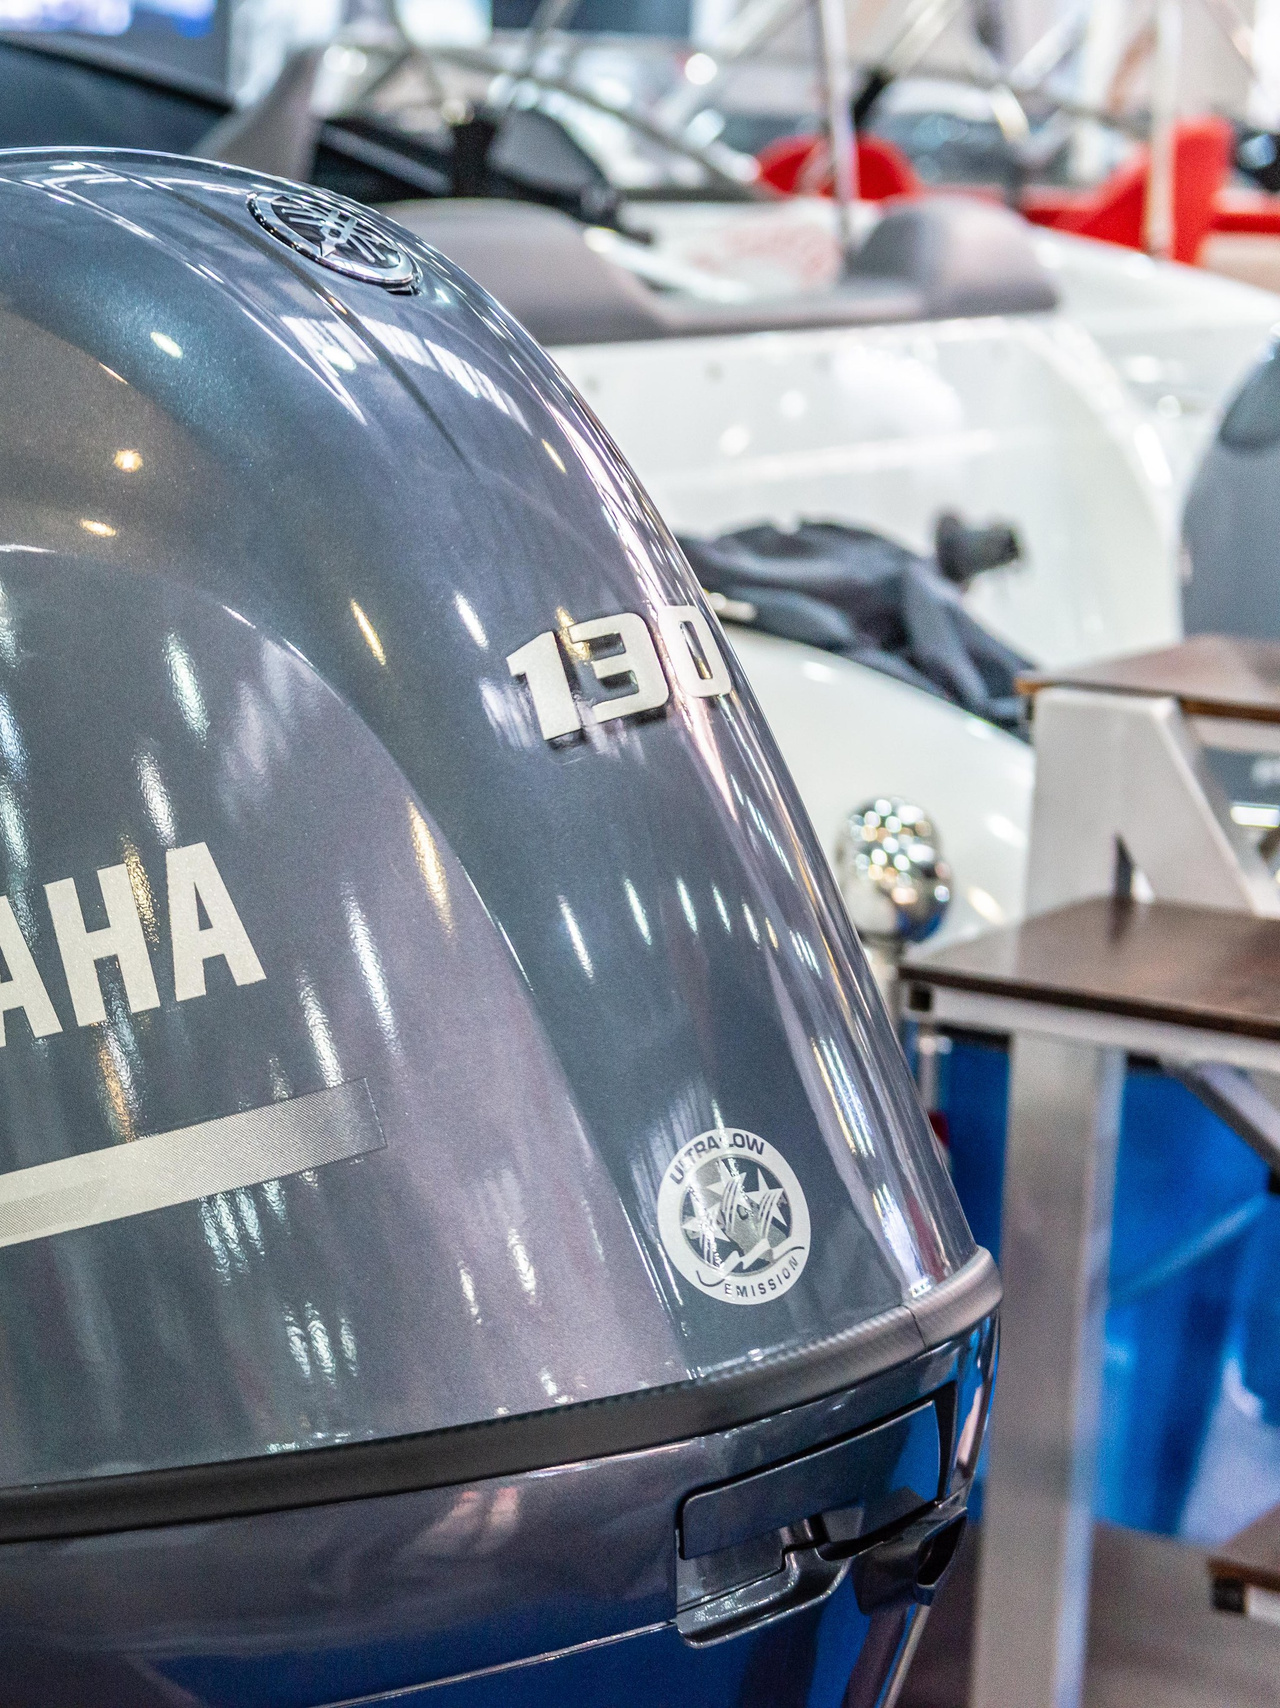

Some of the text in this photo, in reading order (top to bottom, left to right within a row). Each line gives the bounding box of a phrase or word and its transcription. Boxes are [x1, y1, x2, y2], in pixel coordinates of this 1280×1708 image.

[506, 605, 732, 741] 130
[669, 1132, 765, 1185] UTRA-OW
[724, 1255, 799, 1298] EMISSION
